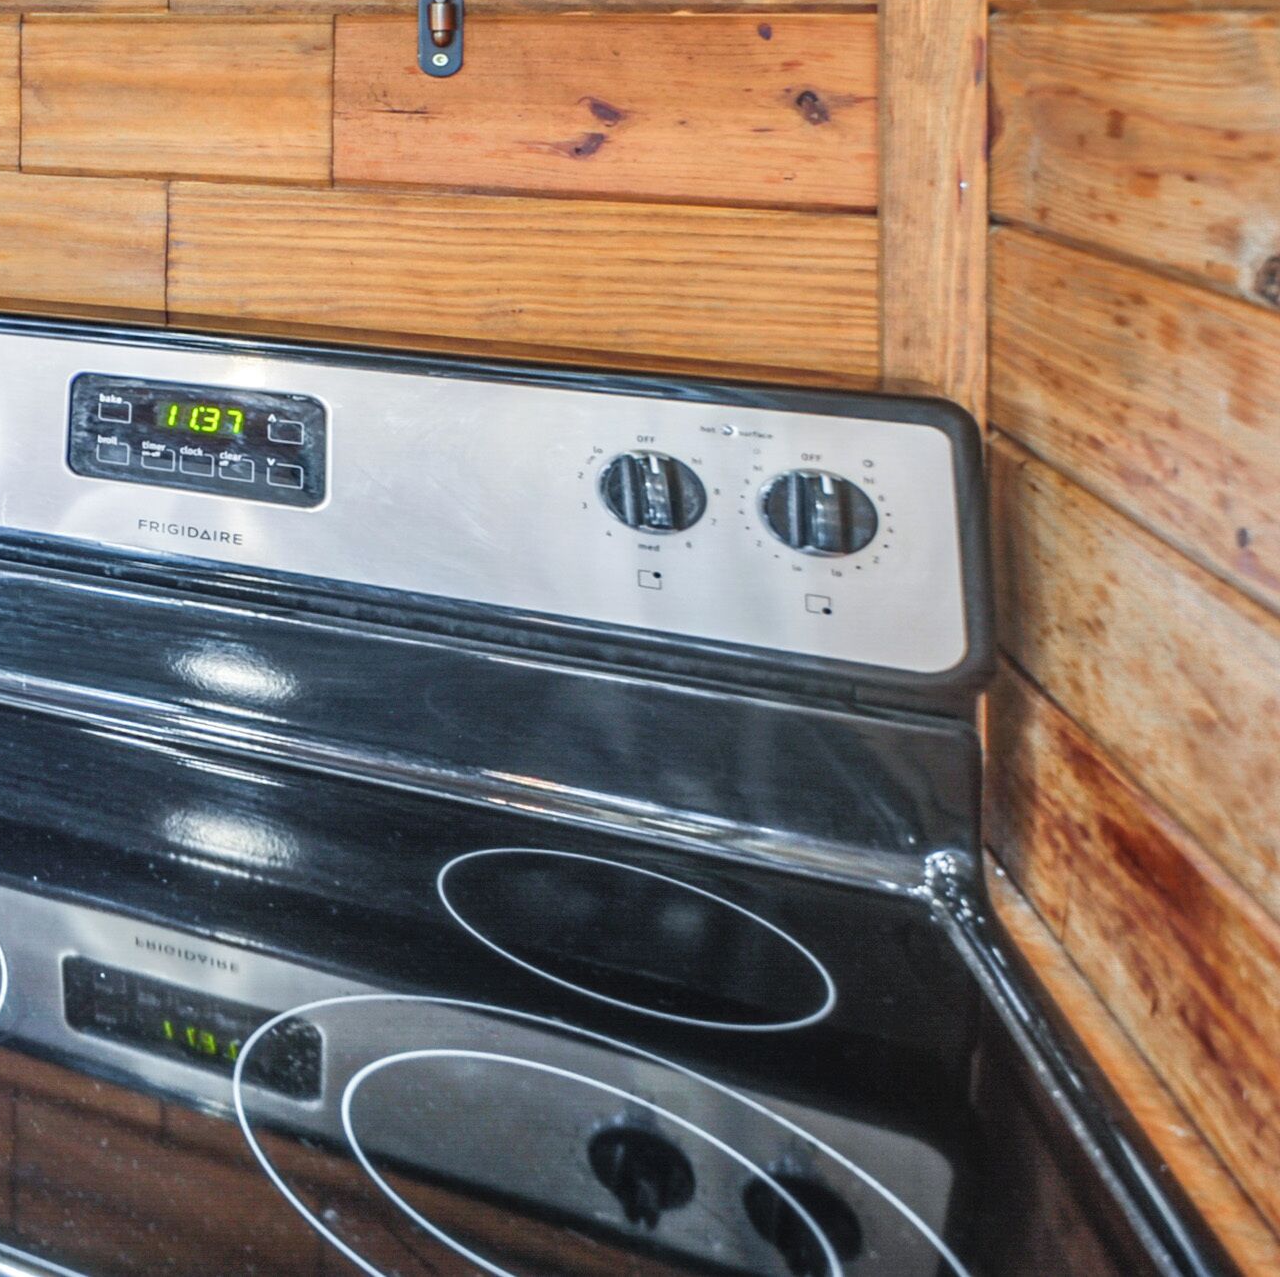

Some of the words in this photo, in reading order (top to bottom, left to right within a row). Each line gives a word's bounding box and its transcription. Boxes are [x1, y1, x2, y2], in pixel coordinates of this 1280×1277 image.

[99, 393, 123, 405] bake
[167, 404, 244, 435] 11:37
[97, 434, 118, 446] broil
[637, 435, 656, 443] OFF
[141, 440, 166, 452] timer
[179, 445, 203, 457] clock
[219, 451, 243, 462] clear
[801, 453, 823, 463] OFF
[137, 519, 244, 546] FRIGIDAIRE
